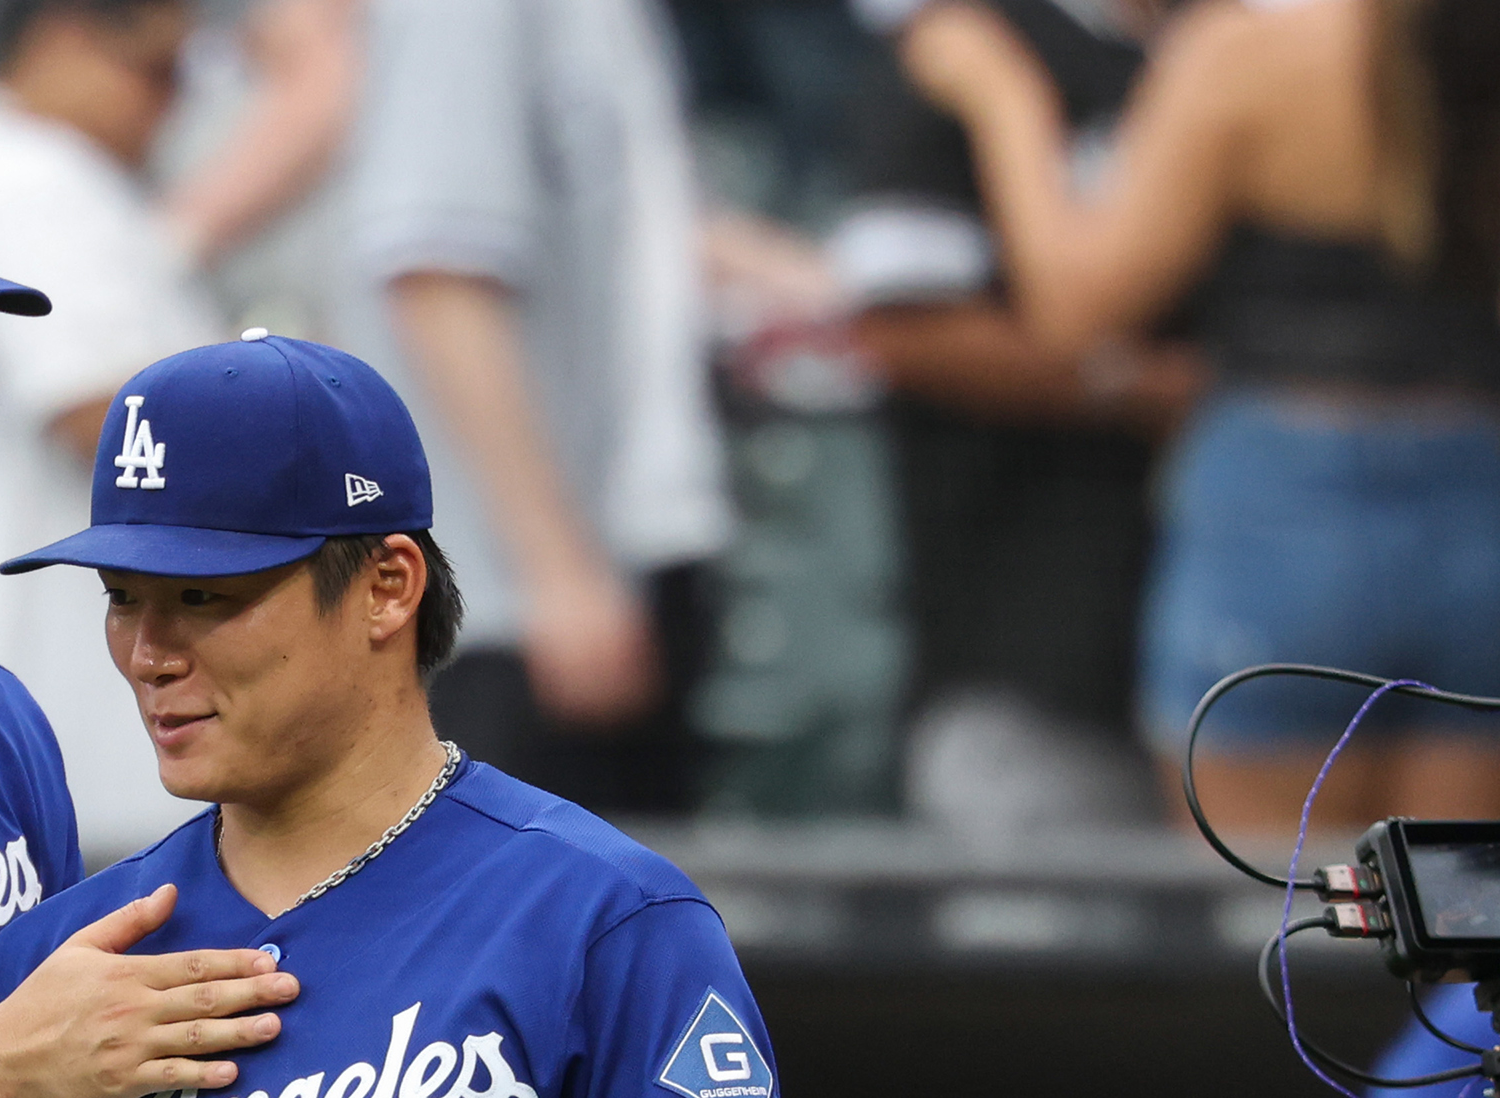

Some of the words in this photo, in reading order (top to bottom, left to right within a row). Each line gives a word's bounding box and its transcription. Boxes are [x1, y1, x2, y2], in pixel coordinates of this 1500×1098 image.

[114, 395, 166, 490] LA
[700, 1033, 751, 1082] G
[700, 1086, 767, 1098] GUGGENHEIM
